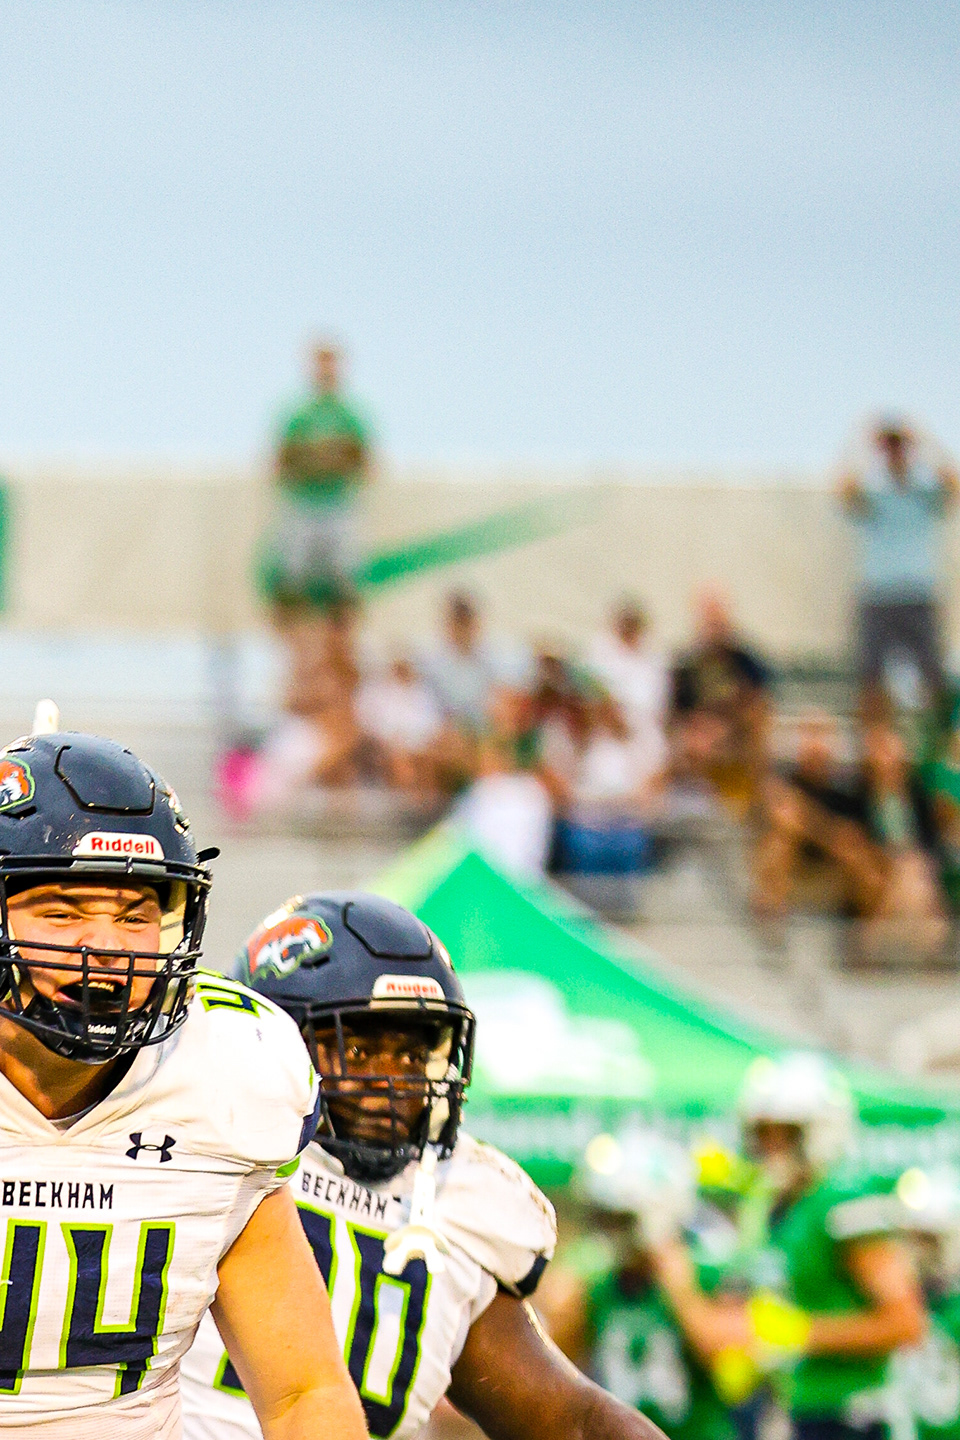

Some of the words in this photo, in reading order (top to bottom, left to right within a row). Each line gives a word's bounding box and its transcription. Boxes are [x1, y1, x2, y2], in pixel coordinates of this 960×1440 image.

[91, 837, 154, 854] Riddell
[195, 966, 276, 1019] 4
[1, 1180, 114, 1210] BECKHAM
[301, 1170, 388, 1220] BECKHAM
